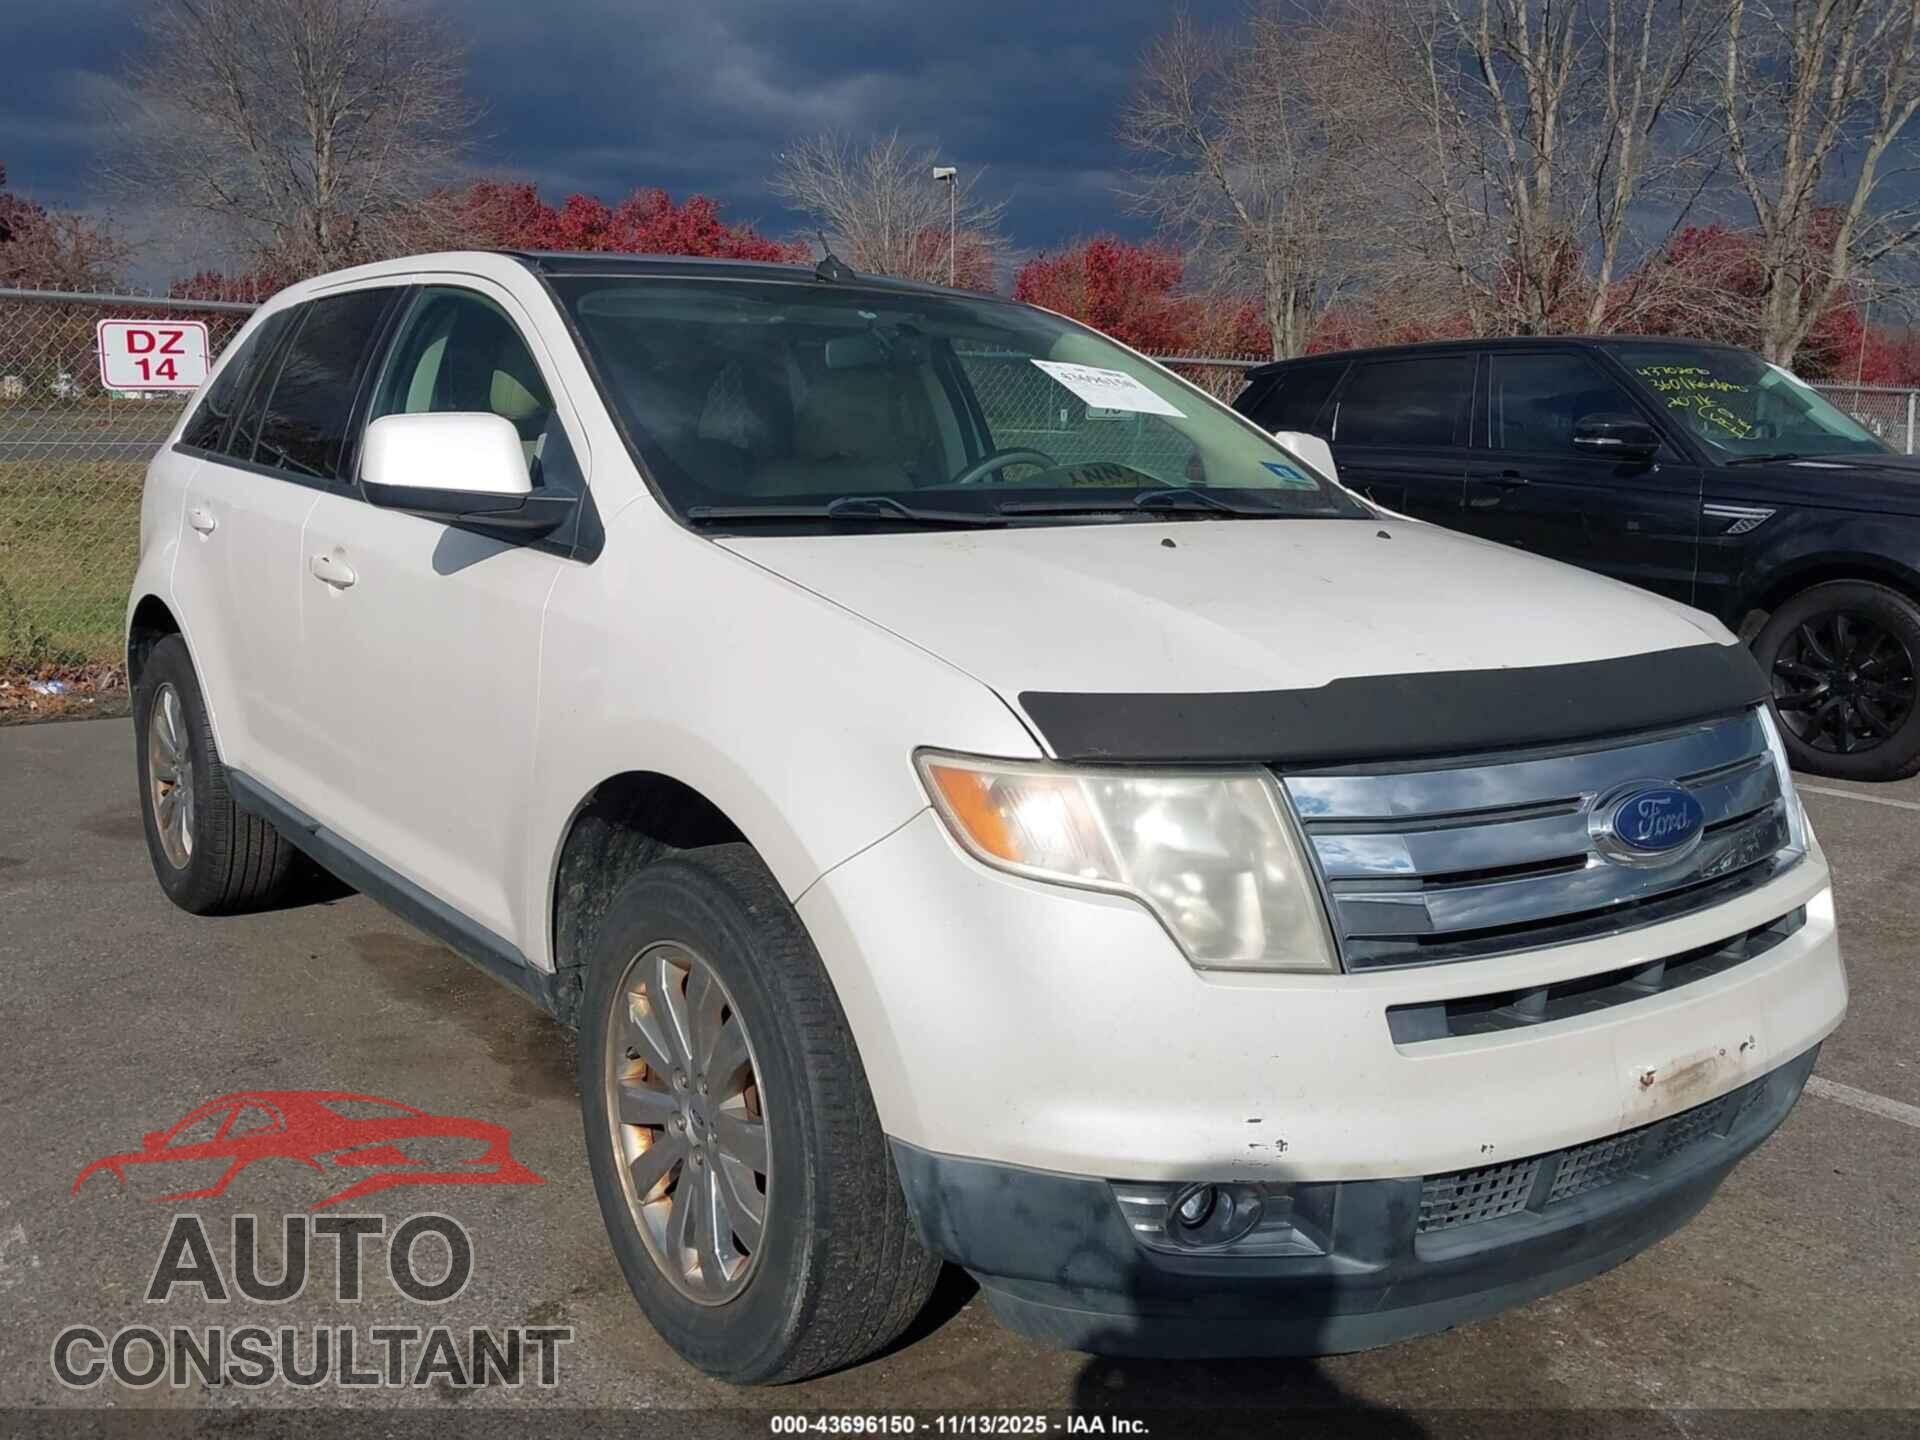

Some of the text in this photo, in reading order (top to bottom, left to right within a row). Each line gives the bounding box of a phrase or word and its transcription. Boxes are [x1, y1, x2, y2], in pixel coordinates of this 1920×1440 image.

[126, 330, 185, 354] DZ
[134, 358, 178, 381] 14
[1634, 796, 1692, 840] Ford
